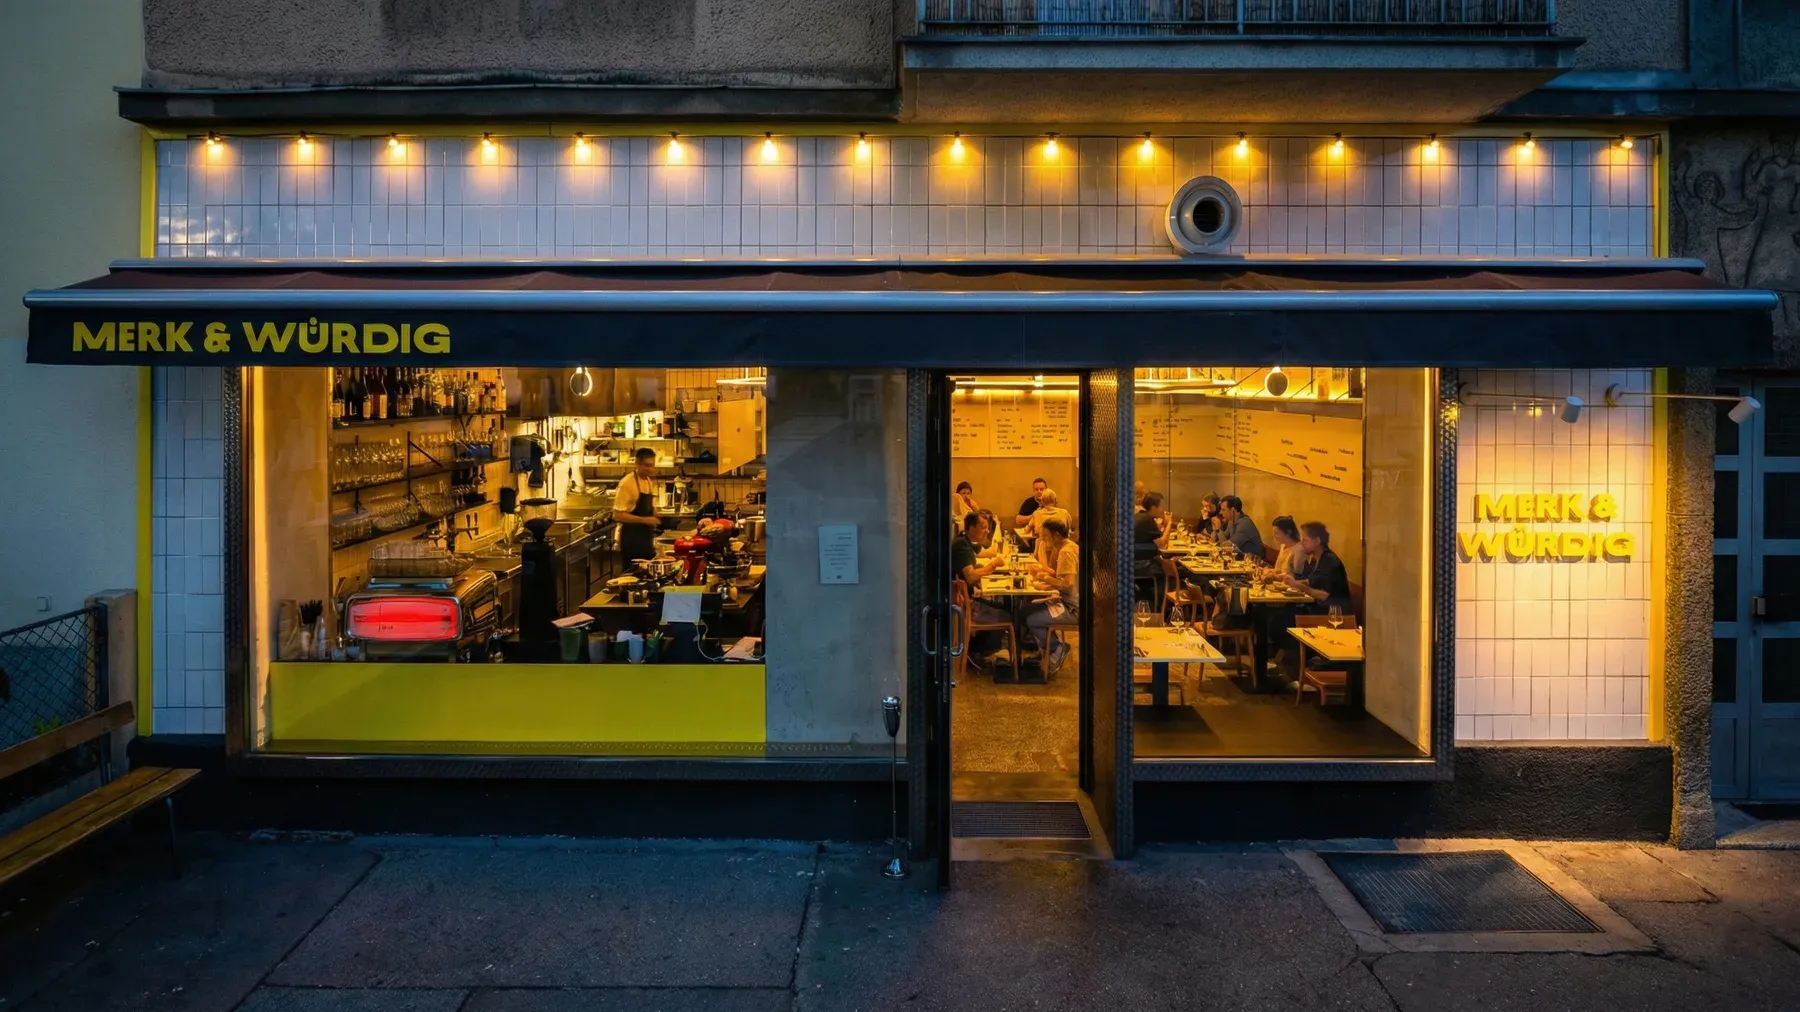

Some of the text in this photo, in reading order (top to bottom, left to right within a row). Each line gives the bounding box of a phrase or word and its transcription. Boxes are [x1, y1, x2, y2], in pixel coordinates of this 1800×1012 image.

[72, 316, 451, 354] MERK & WÜRDIG
[1474, 493, 1618, 521] MERK &
[1457, 524, 1636, 561] WÜRDIG
